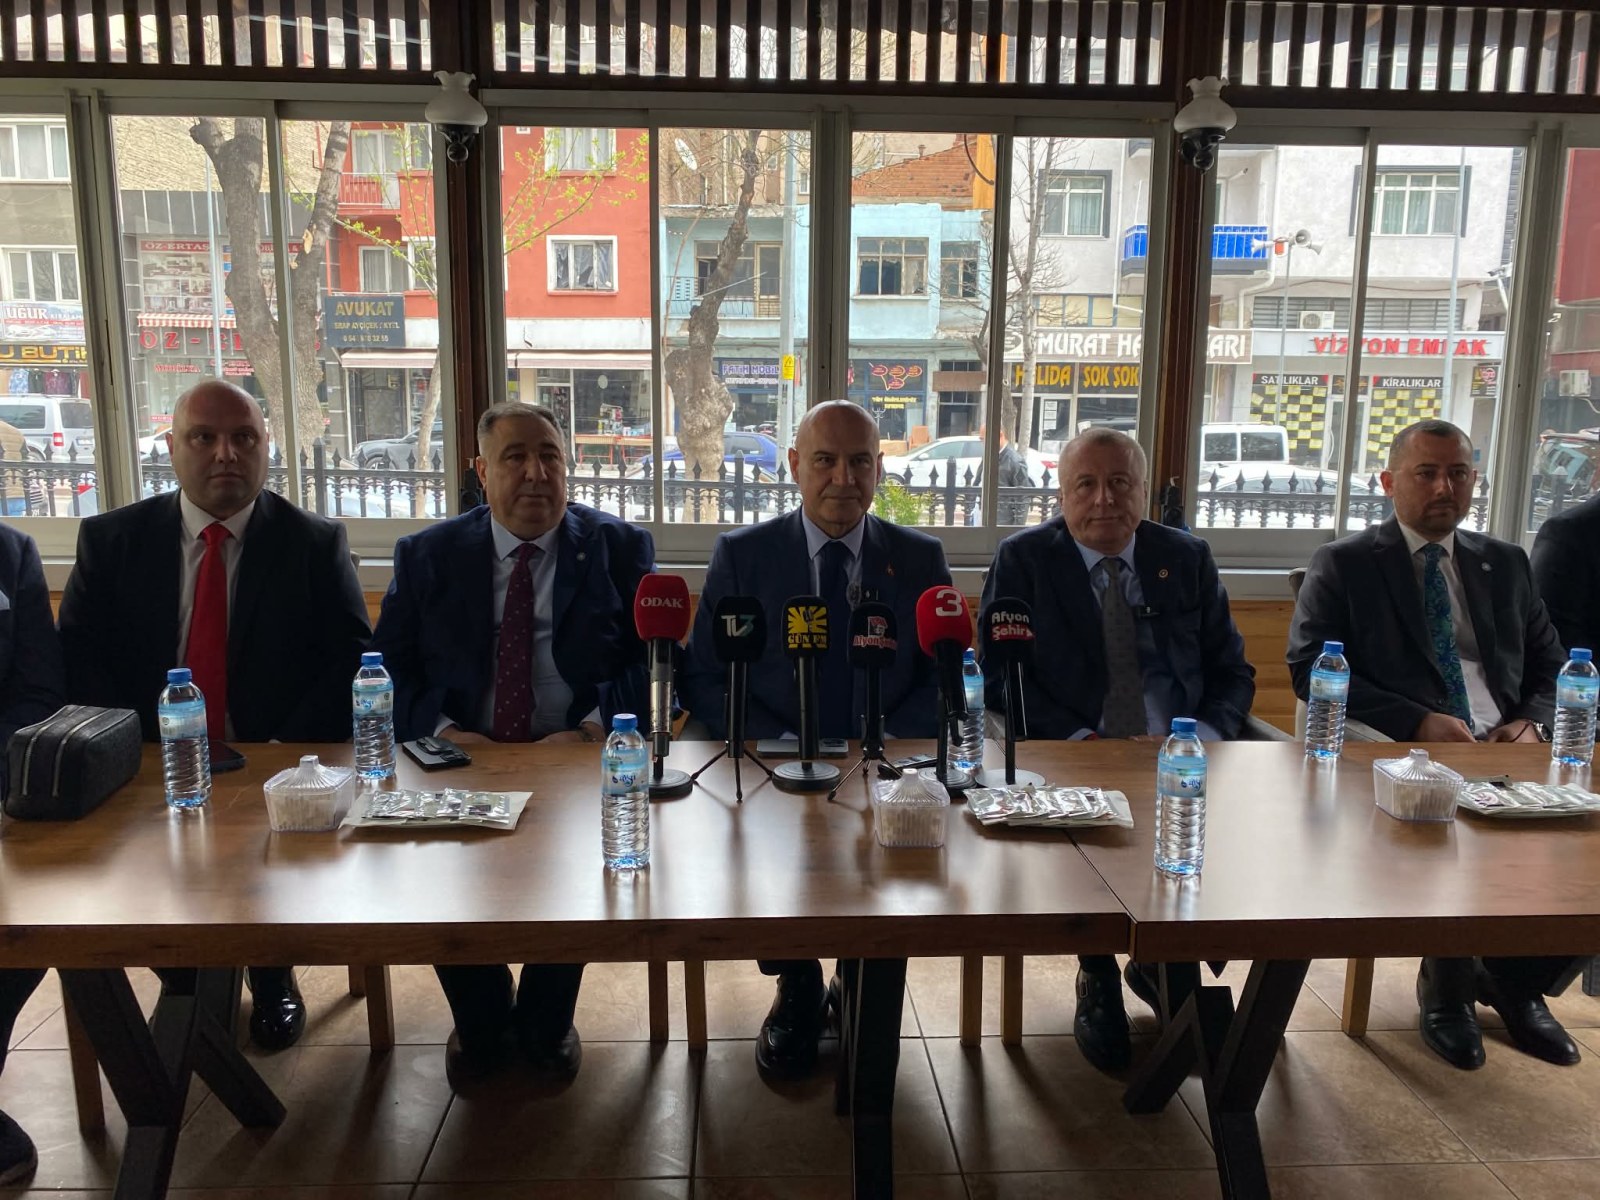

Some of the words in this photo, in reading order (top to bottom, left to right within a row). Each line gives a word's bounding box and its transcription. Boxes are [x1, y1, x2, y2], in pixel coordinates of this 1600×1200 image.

[335, 301, 394, 316] AVUKAT
[1037, 333, 1113, 357] MURAT
[1313, 333, 1401, 355] VİZON
[1015, 365, 1072, 388] HLIDA
[1083, 366, 1110, 388] ŞOK
[1113, 366, 1140, 389] ŞOK
[1260, 375, 1319, 385] SATLIKLAR
[1382, 376, 1442, 388] KİRALIKLAR
[640, 597, 684, 609] ODAK
[935, 589, 964, 617] 3
[991, 610, 1031, 625] Afyon
